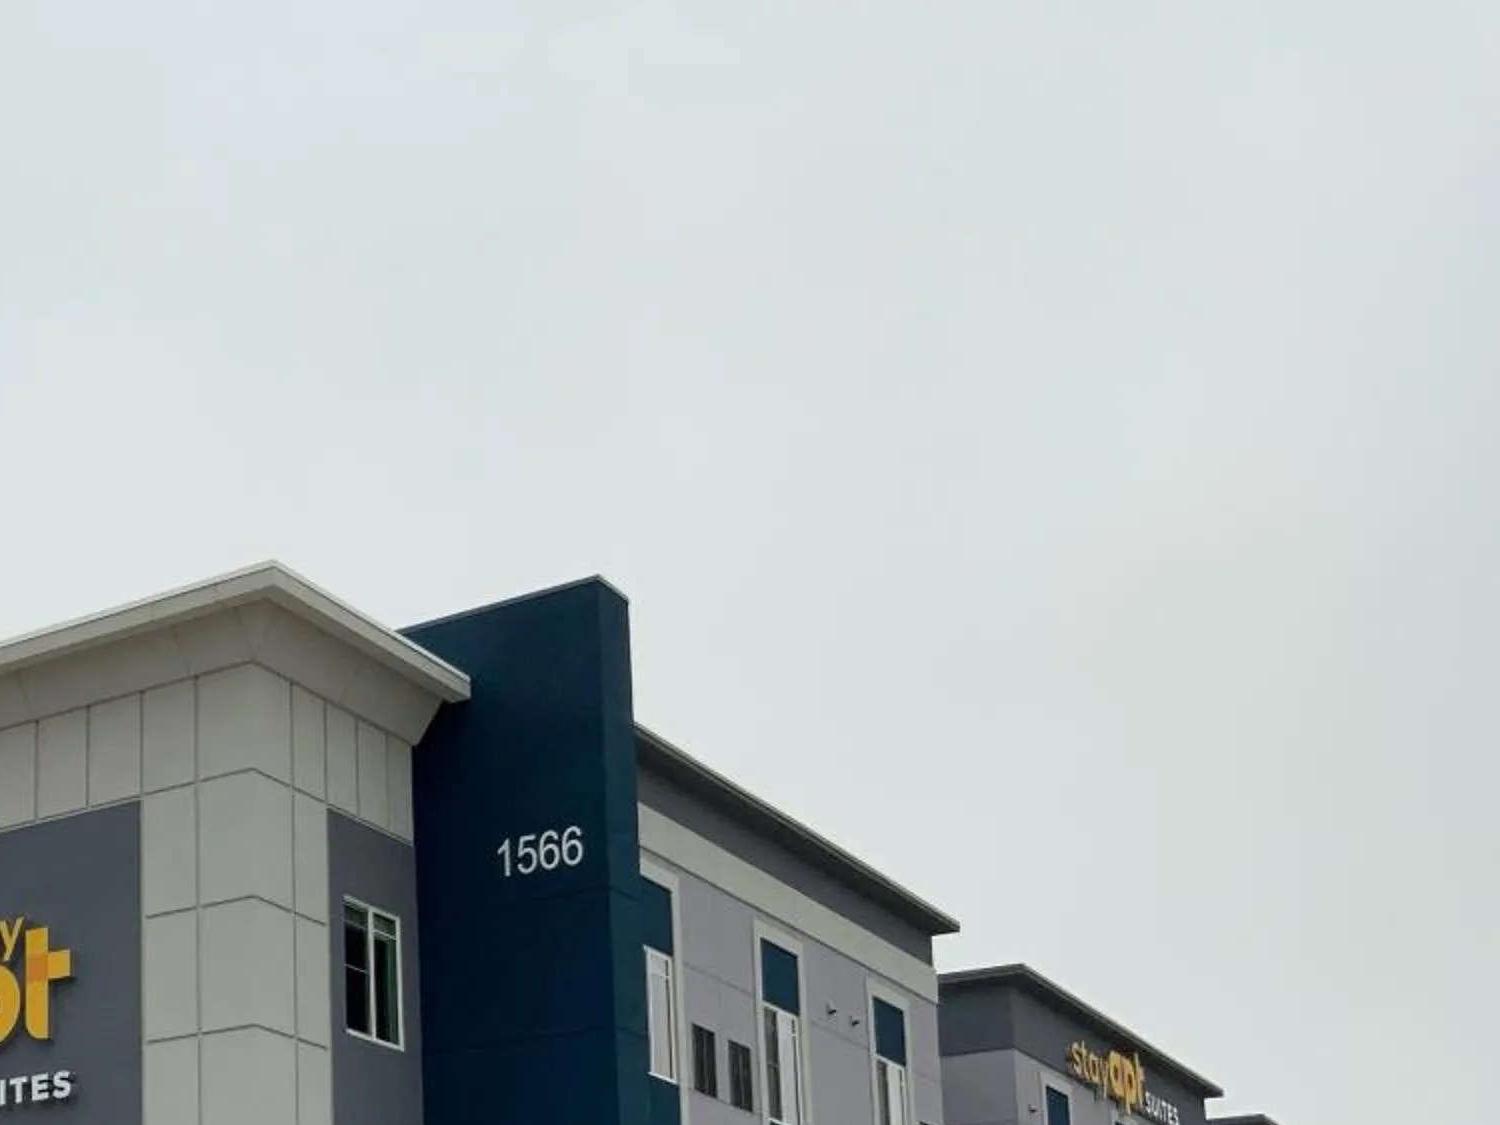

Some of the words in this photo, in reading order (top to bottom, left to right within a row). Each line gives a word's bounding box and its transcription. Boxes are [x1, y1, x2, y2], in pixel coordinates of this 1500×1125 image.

[497, 825, 584, 877] 1566
[1070, 1040, 1110, 1099] stay
[1109, 1050, 1145, 1115] apt
